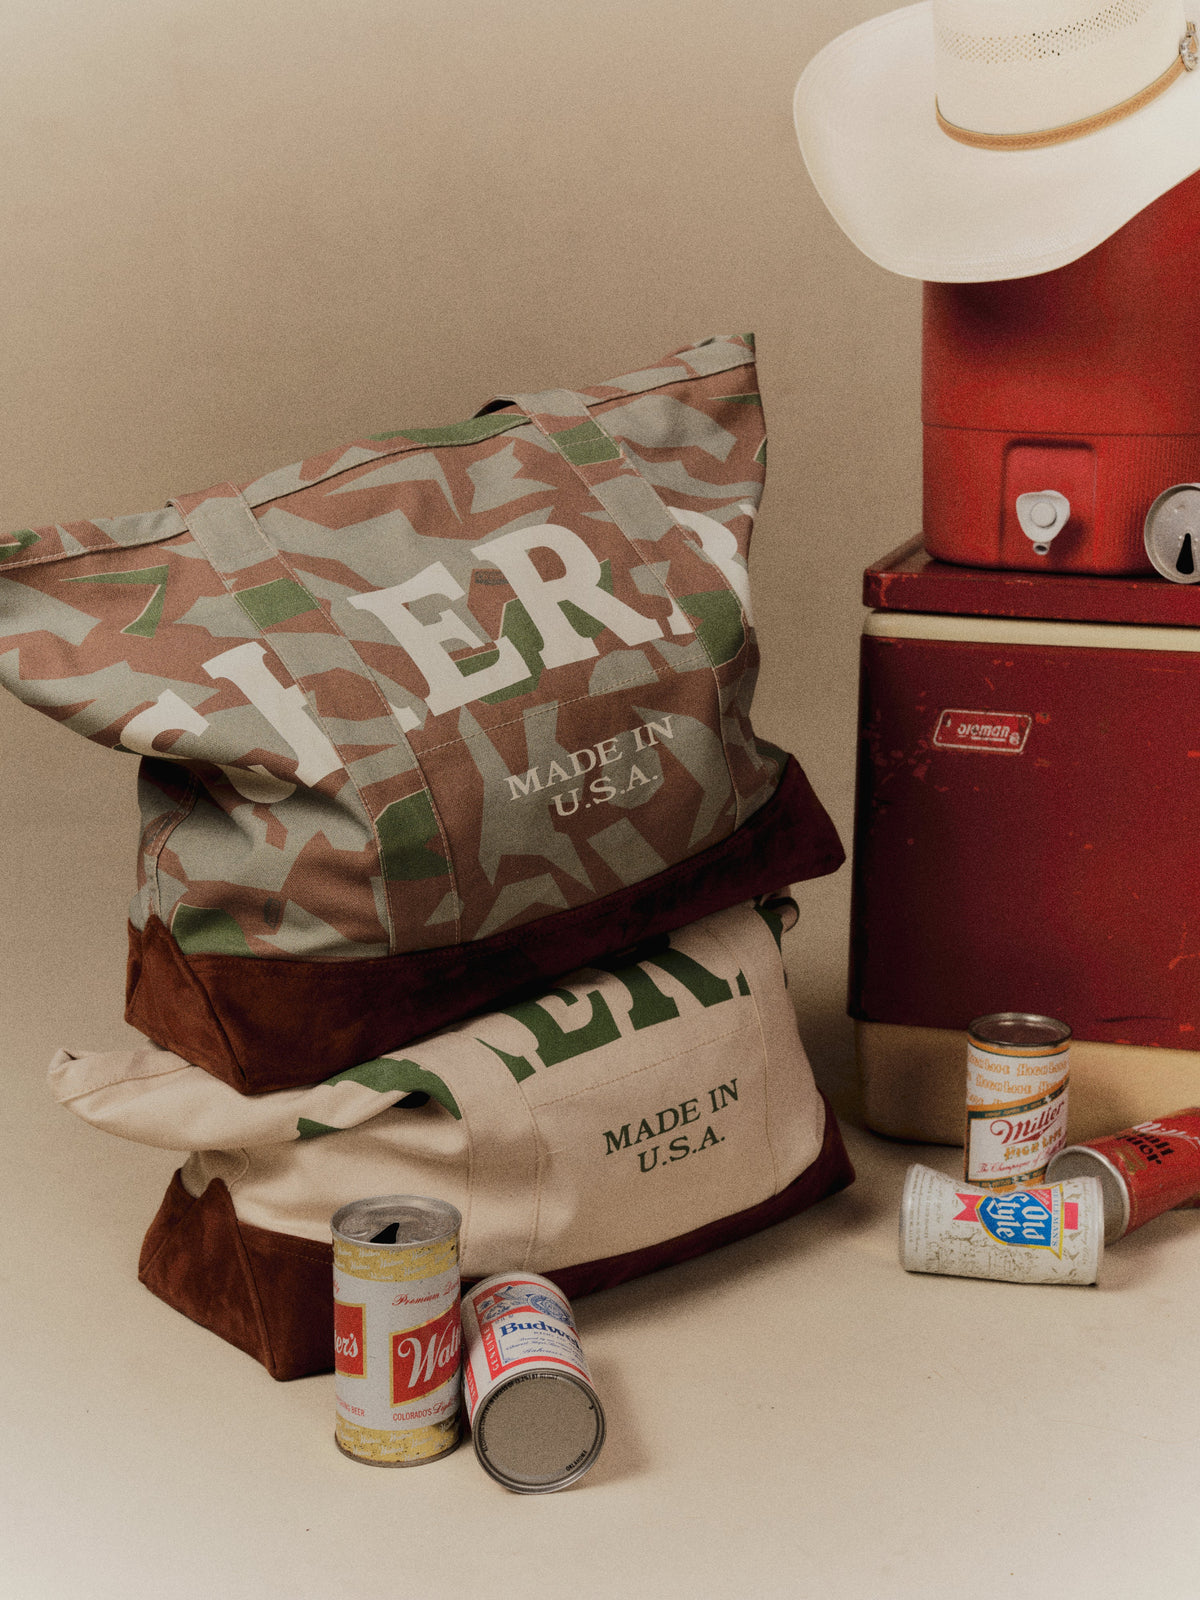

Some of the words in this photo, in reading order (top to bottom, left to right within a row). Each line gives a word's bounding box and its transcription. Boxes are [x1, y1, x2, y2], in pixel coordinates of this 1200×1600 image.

[503, 737, 623, 801] MADE
[631, 715, 674, 752] IN
[551, 764, 658, 817] U.S.A.
[602, 1098, 702, 1156] MADE
[708, 1078, 739, 1113] IN
[990, 1101, 1064, 1146] Miller
[637, 1125, 725, 1173] U.S.A.
[1003, 1142, 1039, 1161] HIGH
[986, 1192, 1030, 1240] Style
[1021, 1206, 1050, 1240] Old
[351, 1405, 365, 1417] BEER
[392, 1408, 432, 1422] COLORADO'S
